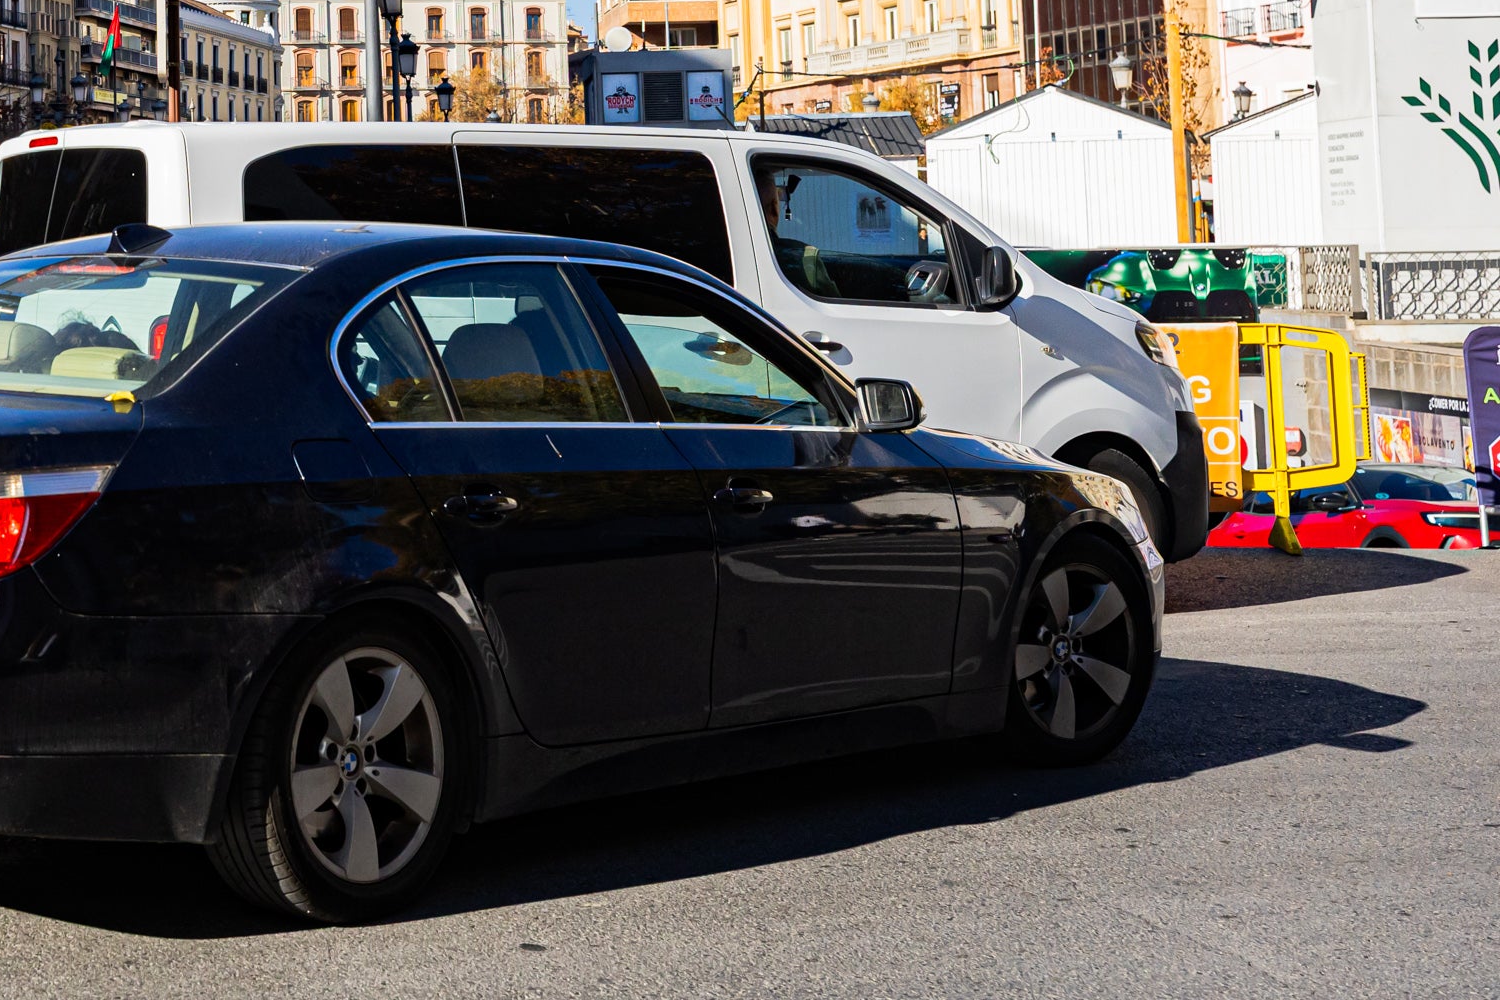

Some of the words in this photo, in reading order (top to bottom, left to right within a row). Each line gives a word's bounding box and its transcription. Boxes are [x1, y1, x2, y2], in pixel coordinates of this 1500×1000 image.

[607, 96, 634, 104] RODYCH
[1449, 399, 1459, 411] POR
[1202, 426, 1236, 455] O
